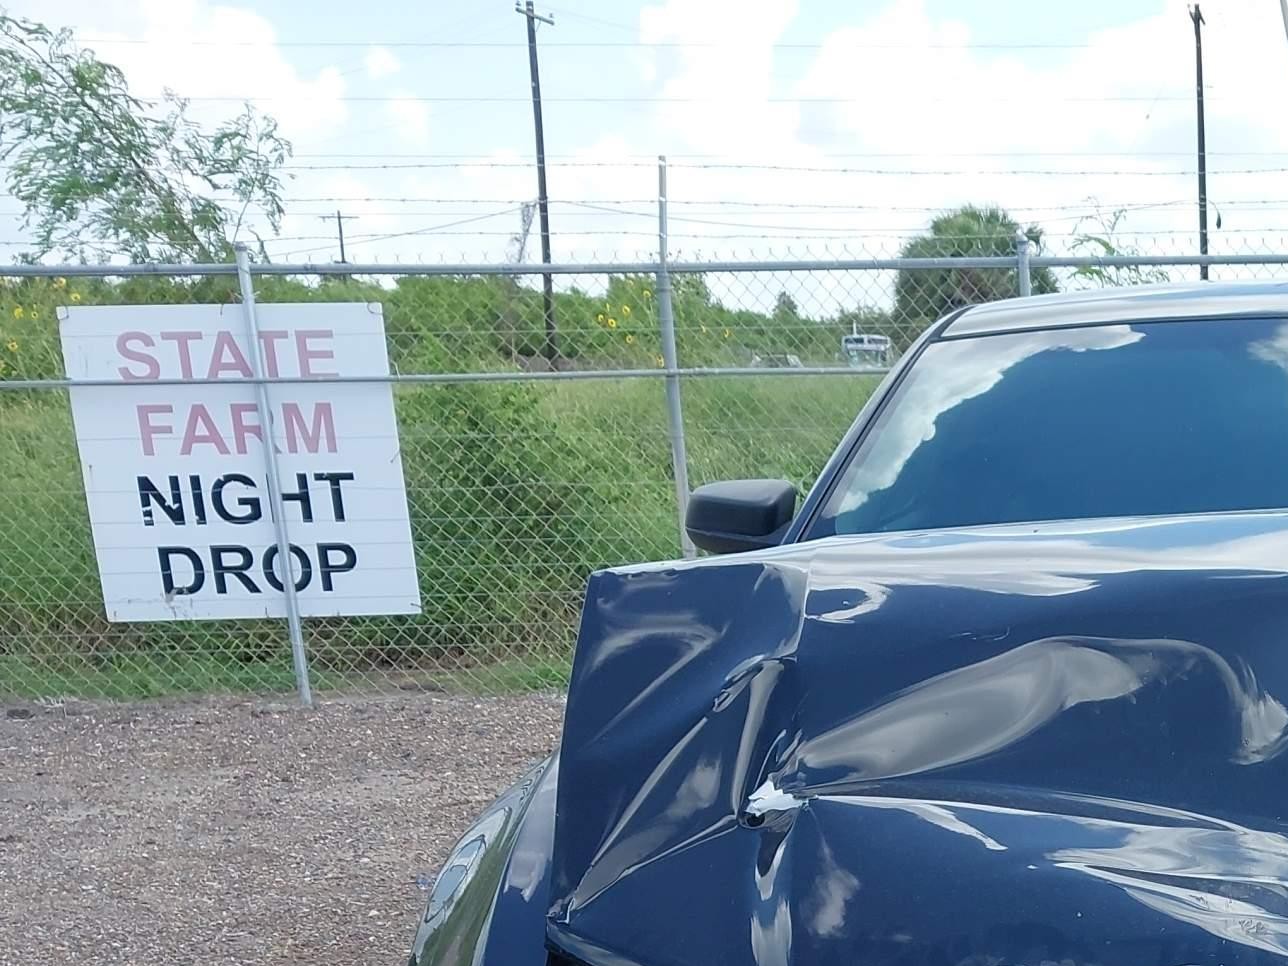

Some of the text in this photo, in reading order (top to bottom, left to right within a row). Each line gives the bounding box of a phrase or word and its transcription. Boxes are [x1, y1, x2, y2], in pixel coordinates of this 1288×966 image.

[115, 329, 340, 383] STATE
[136, 402, 338, 457] FARM
[137, 472, 355, 526] NIGHT
[157, 542, 358, 595] DROP
